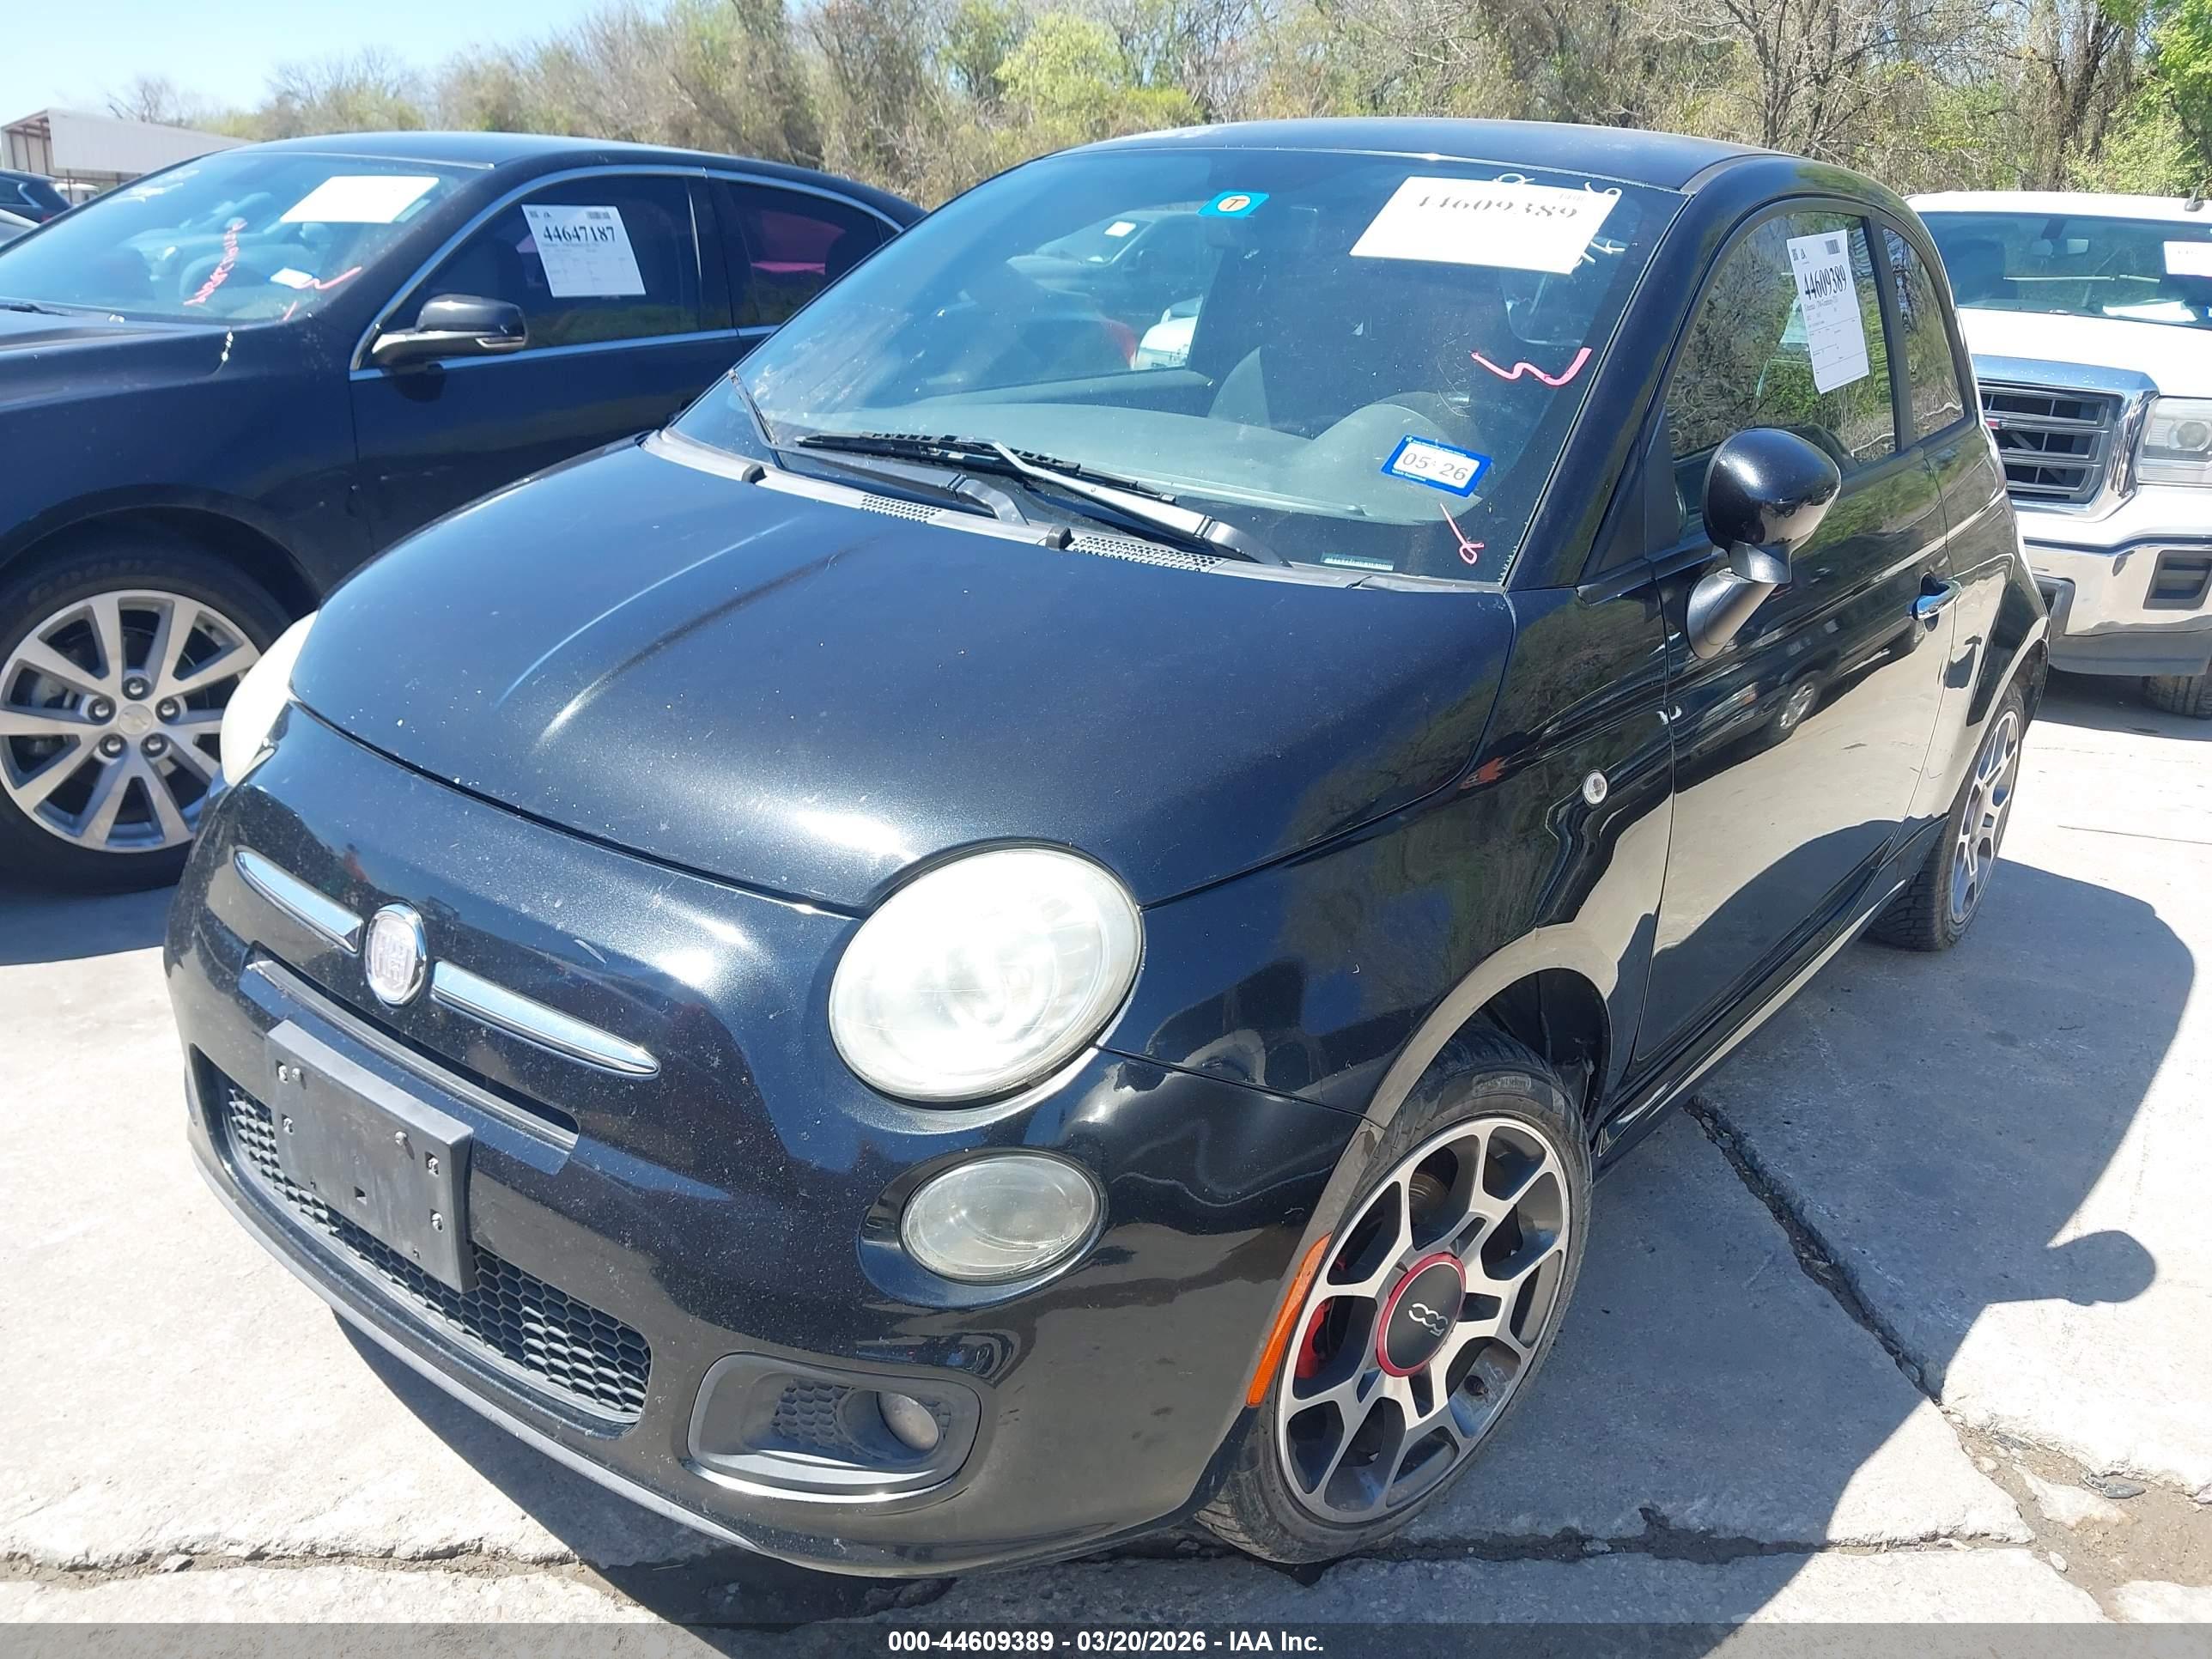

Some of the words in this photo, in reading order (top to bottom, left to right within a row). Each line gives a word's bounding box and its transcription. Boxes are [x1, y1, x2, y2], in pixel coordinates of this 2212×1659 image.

[543, 224, 616, 243] 44647187
[1804, 264, 1847, 300] 44609389
[1402, 453, 1431, 468] 05
[1438, 462, 1468, 481] 26
